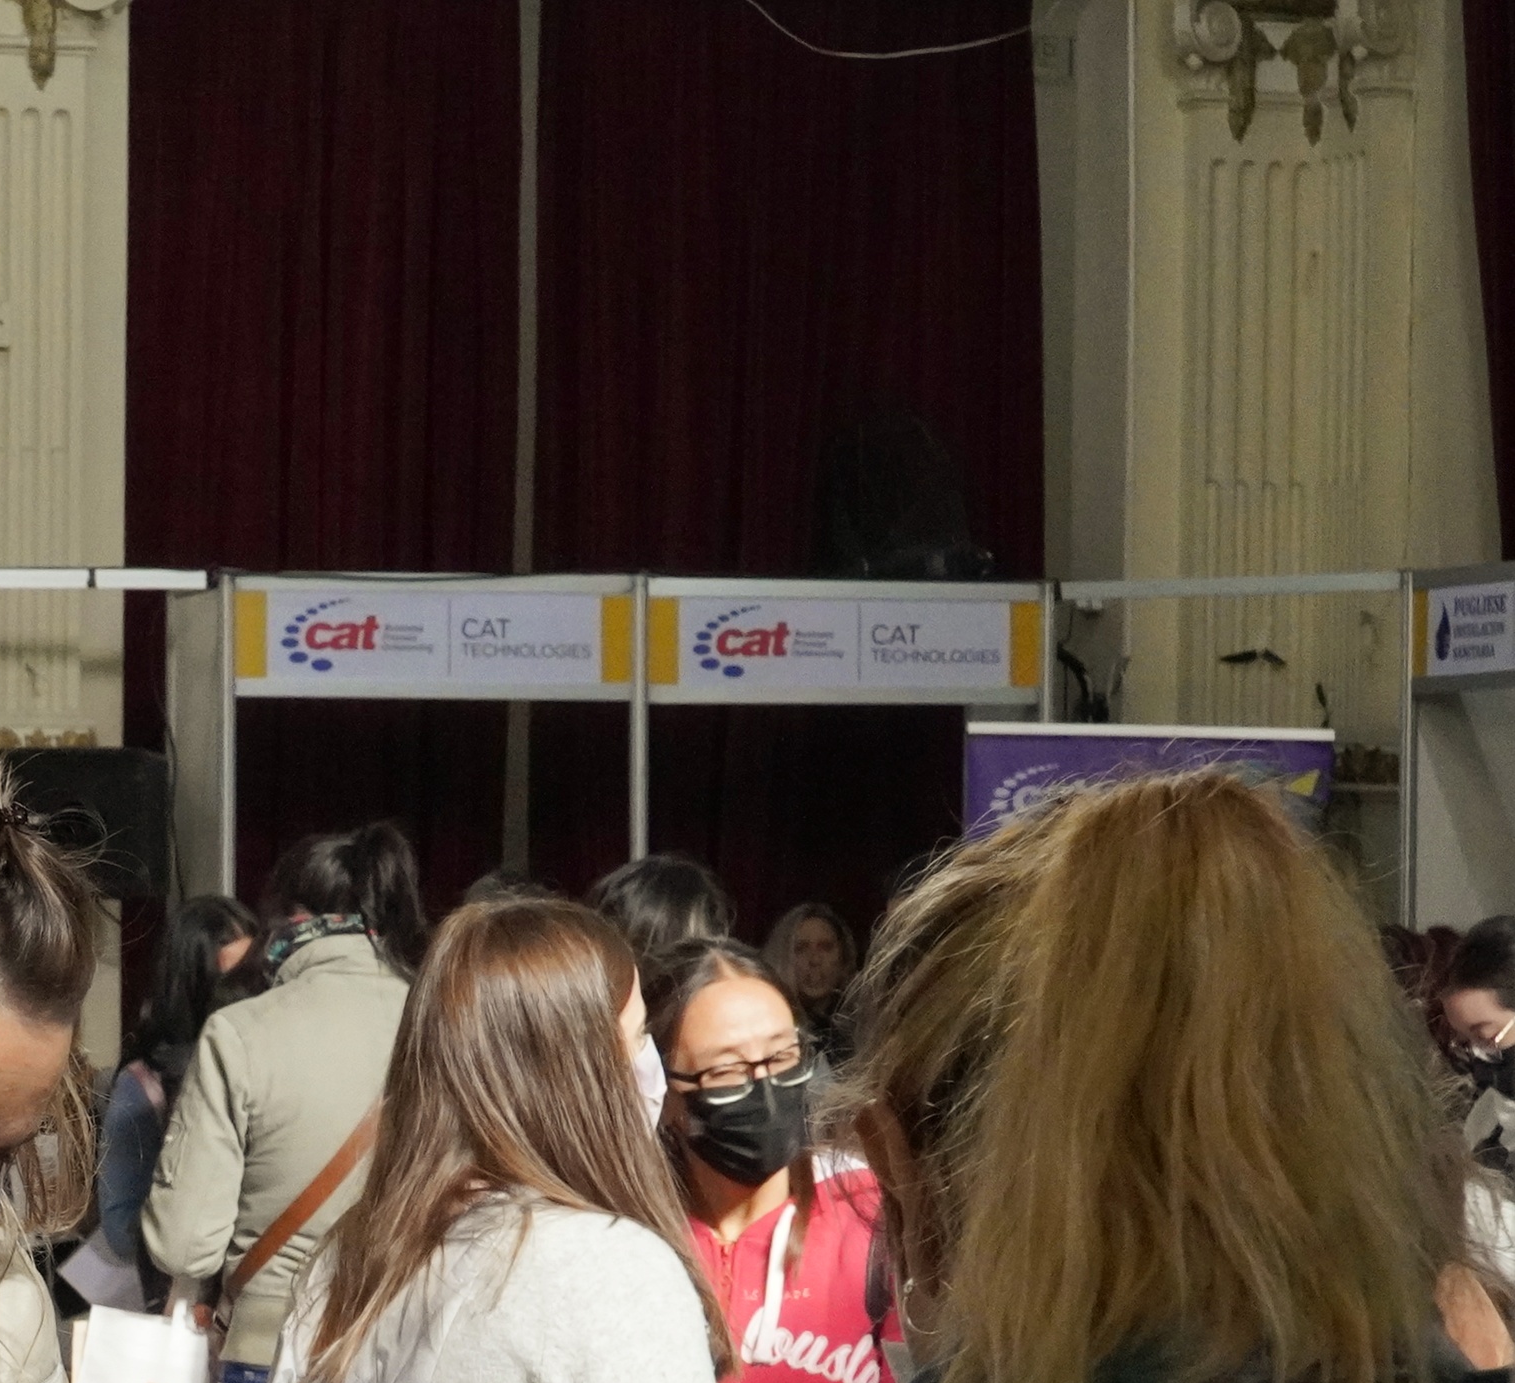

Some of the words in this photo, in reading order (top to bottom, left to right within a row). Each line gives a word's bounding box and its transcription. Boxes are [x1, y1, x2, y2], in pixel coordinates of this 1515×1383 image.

[305, 615, 378, 650] cat
[461, 618, 511, 639] CAT
[716, 621, 789, 656] cat
[871, 624, 920, 645] CAT
[461, 643, 592, 659] TECHNOLOGIES
[872, 648, 1000, 664] TECHNOLOGIES
